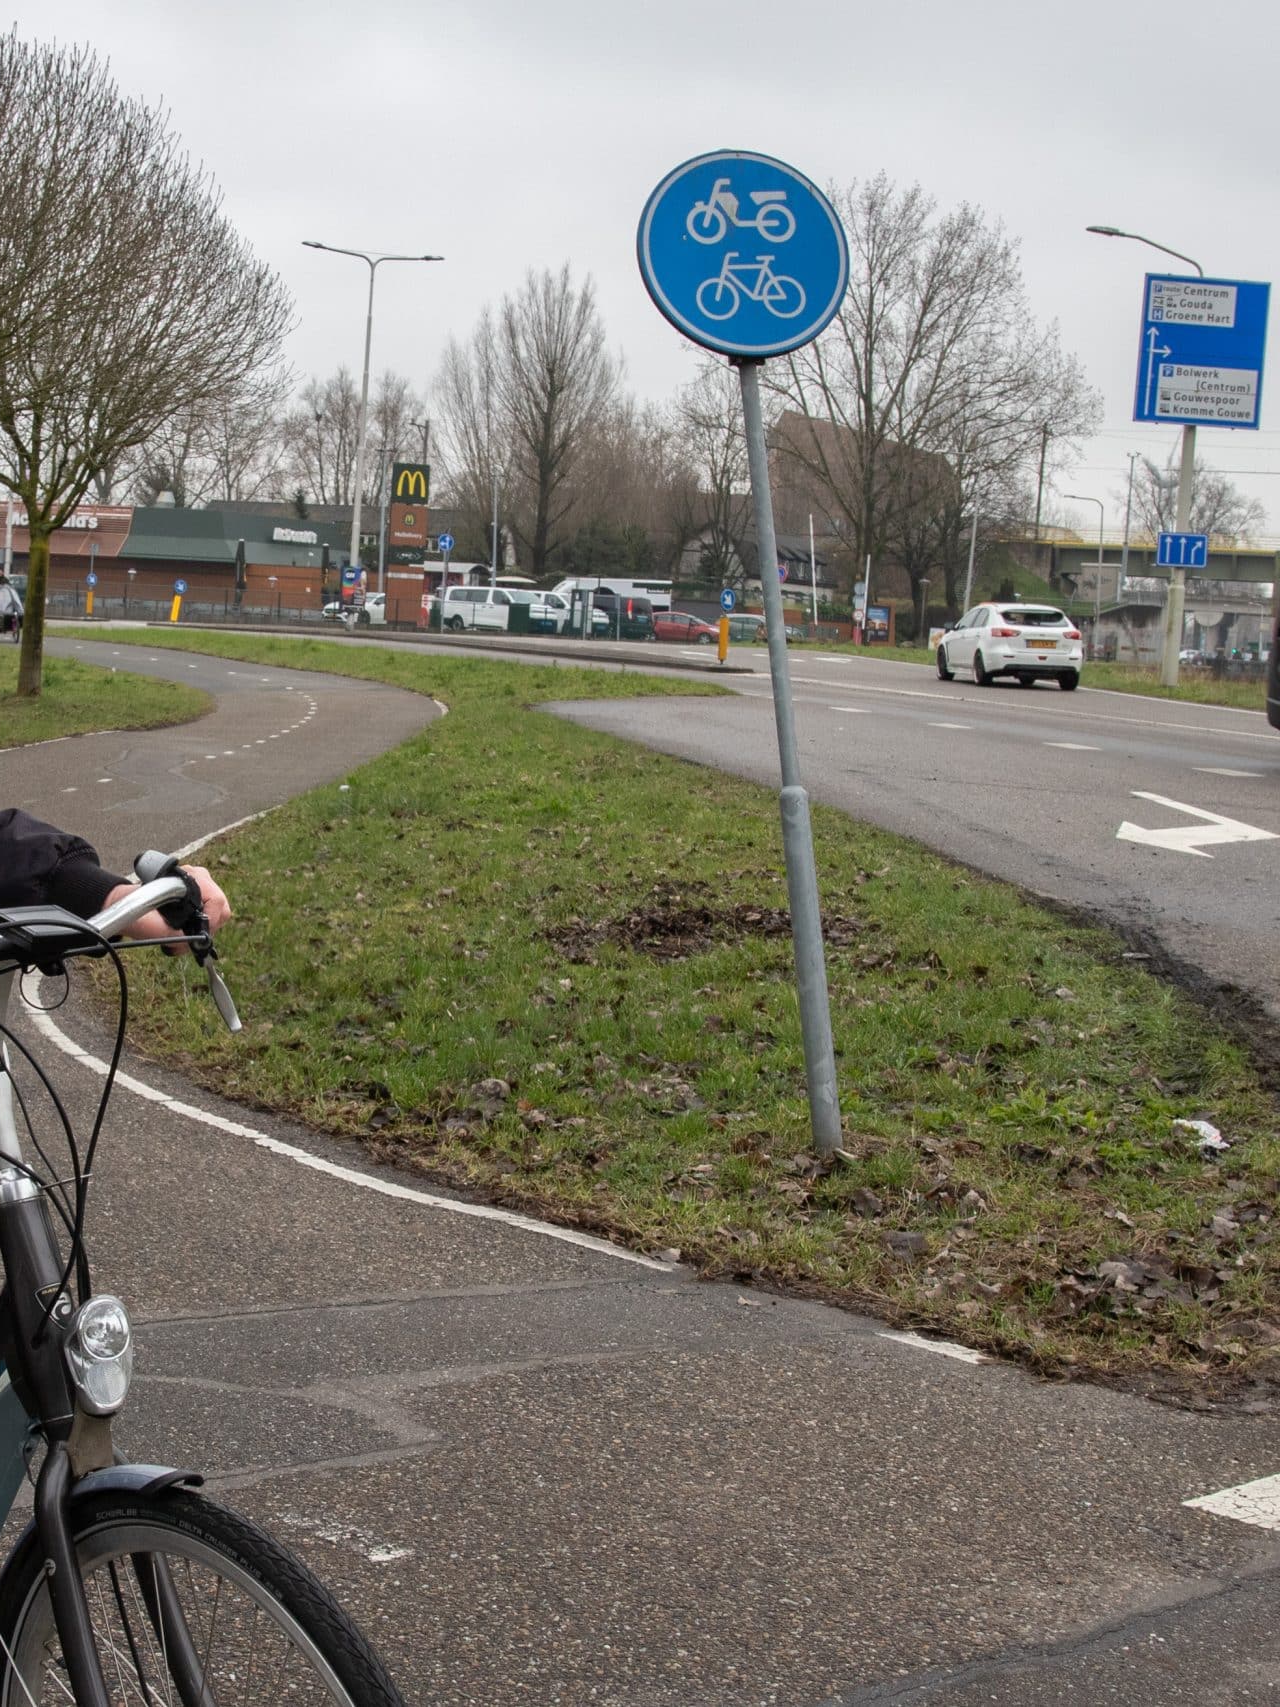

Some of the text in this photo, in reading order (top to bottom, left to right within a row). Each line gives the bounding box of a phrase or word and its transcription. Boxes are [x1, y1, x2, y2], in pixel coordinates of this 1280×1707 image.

[1183, 286, 1229, 298] Centrum
[1179, 299, 1213, 310] Gouda
[1165, 311, 1204, 321] Groene
[1207, 313, 1231, 323] Hart
[1176, 367, 1220, 378] Bolwerk
[1196, 380, 1250, 395] (Centrum)
[1174, 392, 1240, 405] Gouwespoor
[1173, 405, 1250, 418] Kromme Gouwe
